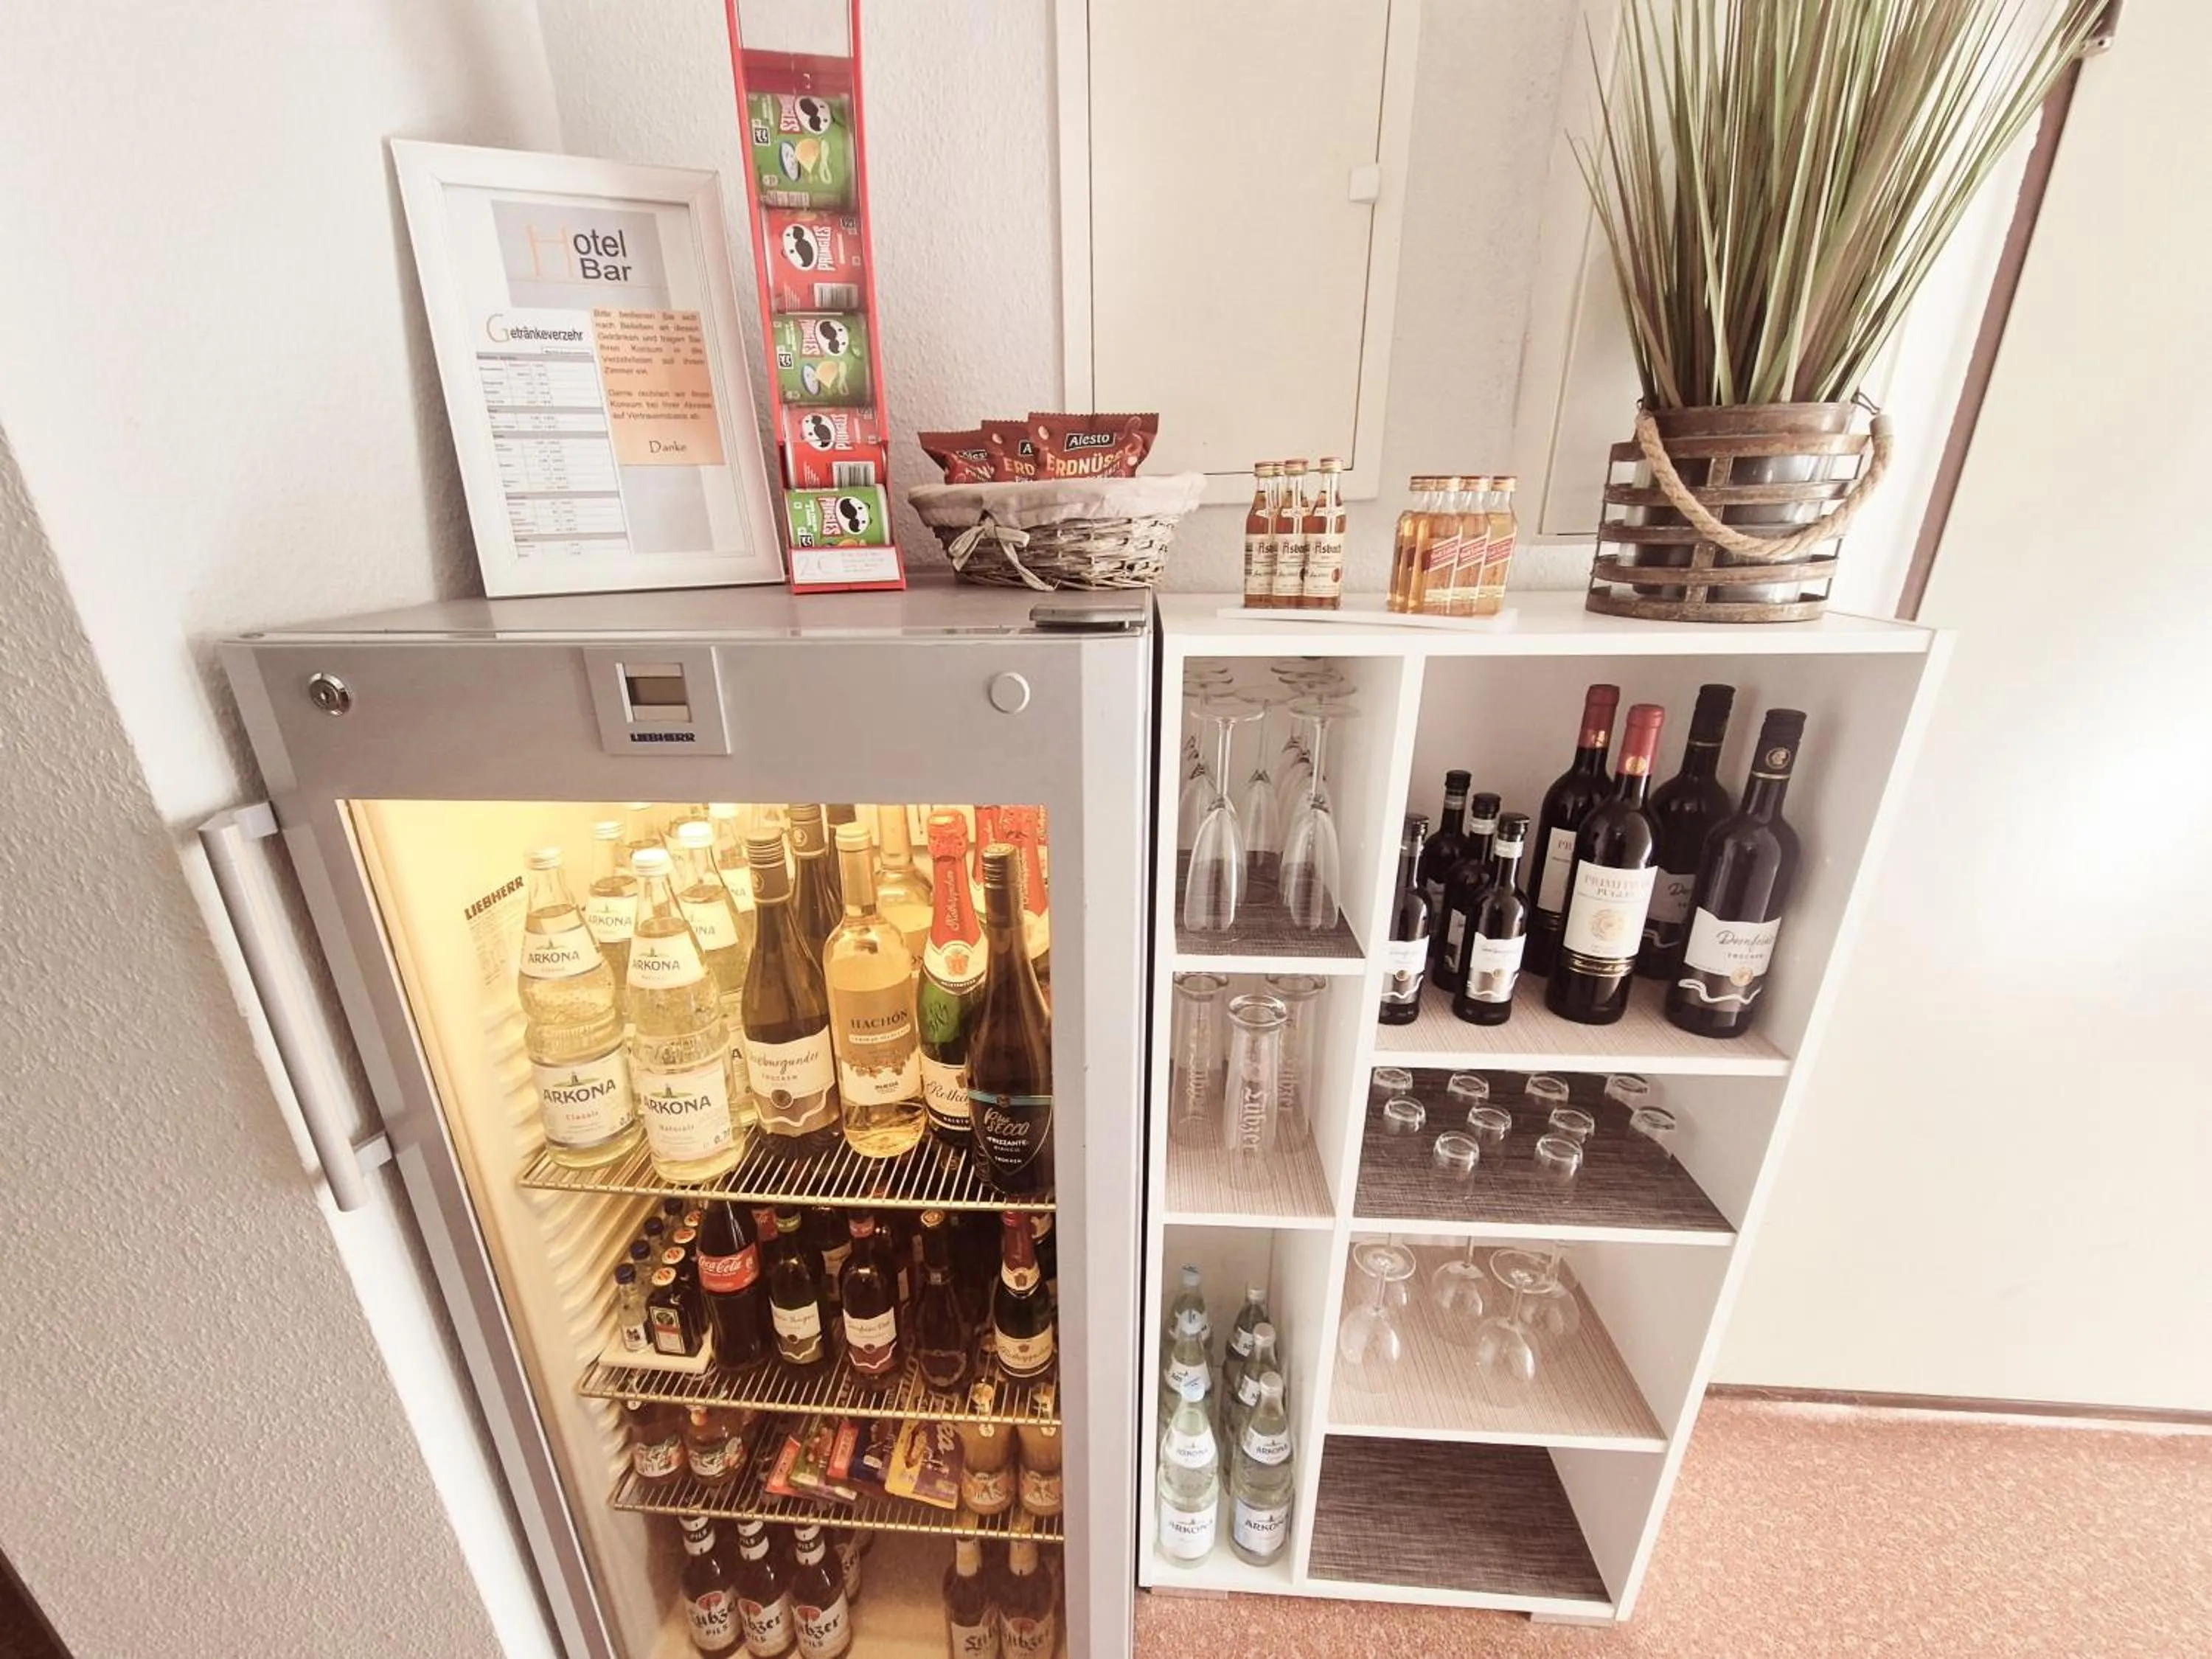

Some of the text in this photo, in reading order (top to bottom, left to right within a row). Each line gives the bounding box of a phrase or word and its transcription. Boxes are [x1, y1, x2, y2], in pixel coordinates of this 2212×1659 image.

[813, 226, 835, 271] PRINGLES
[580, 258, 632, 282] Bar
[486, 313, 584, 343] Getränkeverzehr
[648, 440, 687, 453] Danke
[1068, 434, 1110, 447] Alesto
[818, 497, 842, 535] PRINGLES
[630, 733, 695, 742] LIEBHERR
[464, 875, 524, 920] LIEBHERR
[527, 950, 580, 964] ARKONA
[632, 960, 681, 972] ARKONA
[543, 1079, 616, 1105] ARKONA
[644, 1095, 712, 1116] ARKONA
